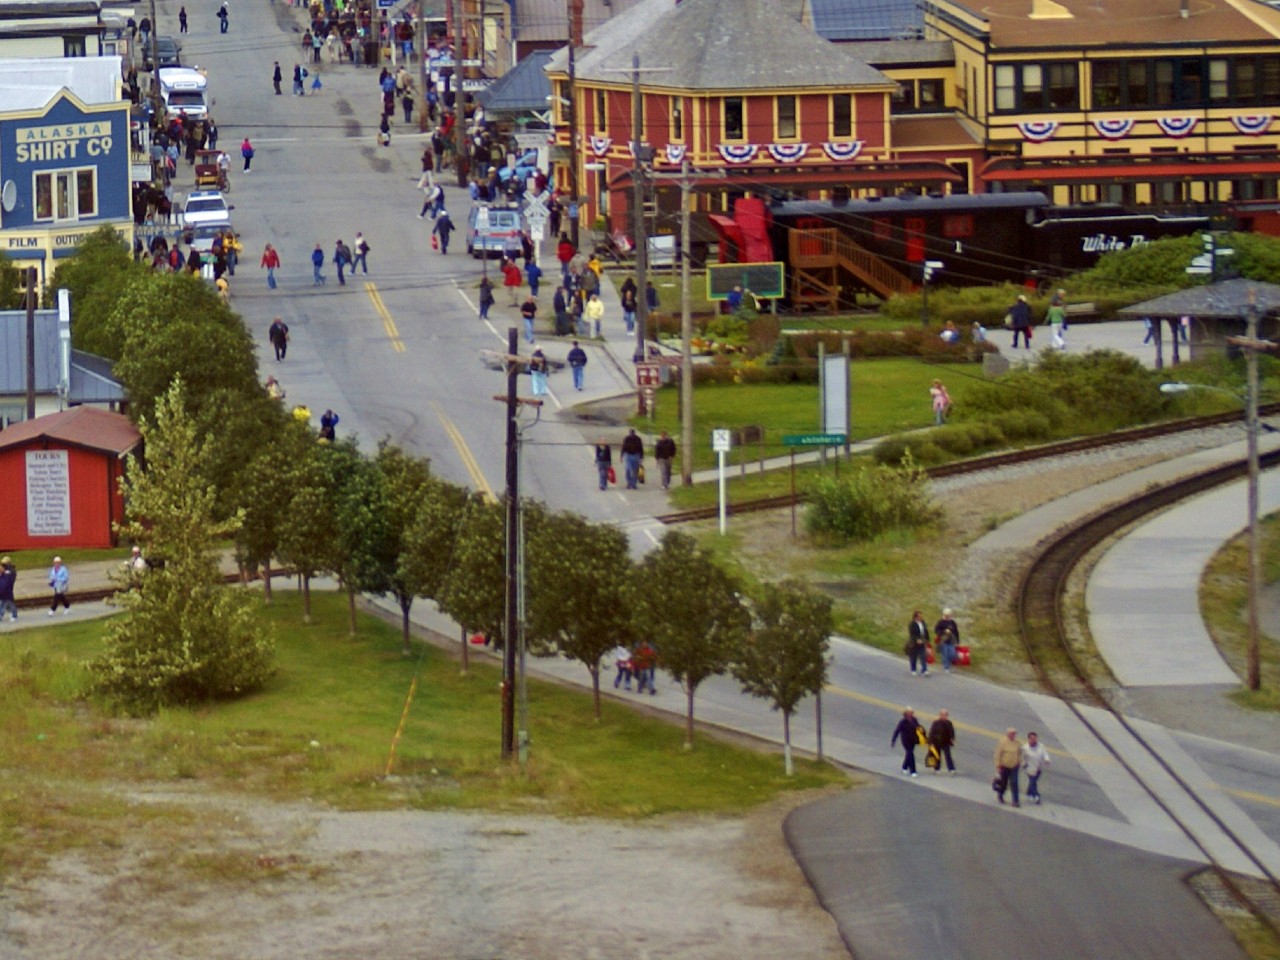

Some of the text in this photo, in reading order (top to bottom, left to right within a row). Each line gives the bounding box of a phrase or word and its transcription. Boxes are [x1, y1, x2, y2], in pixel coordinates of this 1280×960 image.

[26, 124, 101, 140] ALASKA
[16, 139, 79, 163] SHIRT
[9, 237, 37, 248] FILM
[955, 240, 962, 253] 1
[1081, 234, 1125, 251] White
